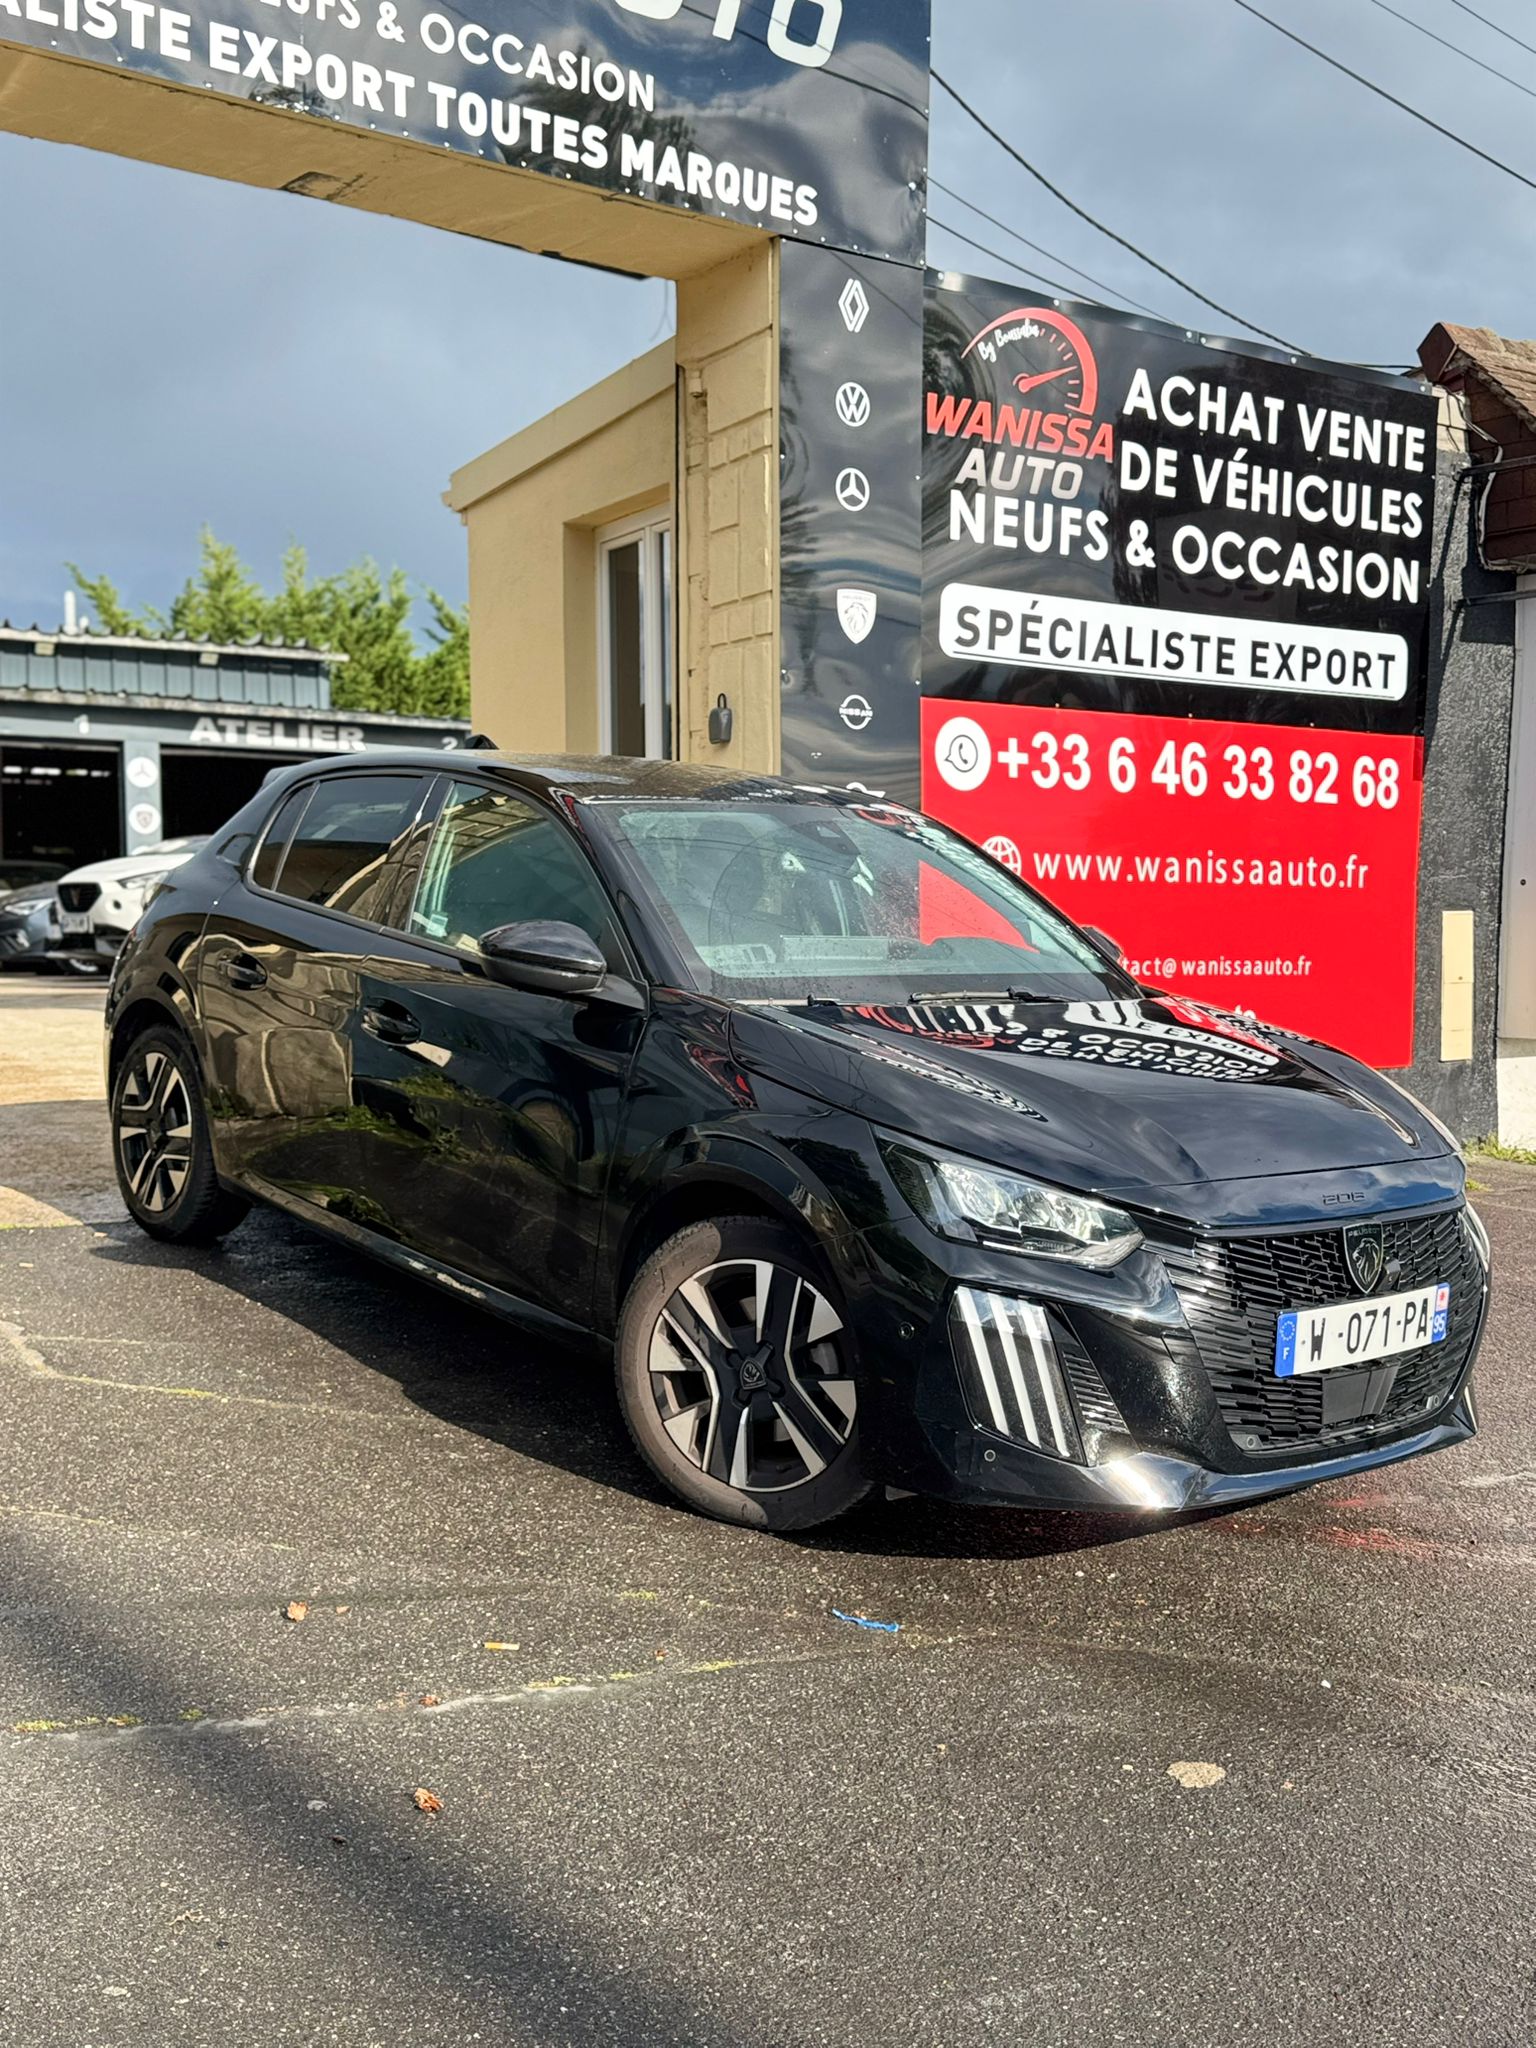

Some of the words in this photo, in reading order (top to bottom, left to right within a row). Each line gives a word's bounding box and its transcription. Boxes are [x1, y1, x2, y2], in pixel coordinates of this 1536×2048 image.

[376, 1, 406, 43] &
[420, 13, 655, 112] OCCASION
[0, 0, 191, 62] LISTE
[209, 22, 415, 117] EXPORT
[428, 82, 608, 169] TOUTES
[620, 134, 818, 227] MARQUES
[926, 391, 1114, 464] WANISSA
[1122, 368, 1285, 445] ACHAT
[1297, 403, 1426, 473] VENTE
[954, 447, 1084, 500] AUTO
[1120, 440, 1178, 498] DE
[1193, 448, 1423, 538] VÉHICULES
[950, 489, 1109, 562] NEUFS
[1125, 519, 1156, 568] &
[1172, 525, 1420, 603] OCCASION
[954, 600, 1236, 675] SPÉCIALISTE
[1250, 639, 1396, 689] EXPORT
[190, 717, 367, 751] ATELIER
[997, 731, 1091, 791] +33
[1108, 737, 1136, 793] 6
[1151, 740, 1208, 797] 46
[1223, 745, 1274, 800] 33
[1288, 750, 1339, 804] 82
[1352, 756, 1399, 809] 68
[1033, 850, 1369, 888] www.wanissaauto.fr
[1117, 957, 1178, 978] tact@
[1282, 1347, 1290, 1360] F
[1433, 1312, 1447, 1333] 95
